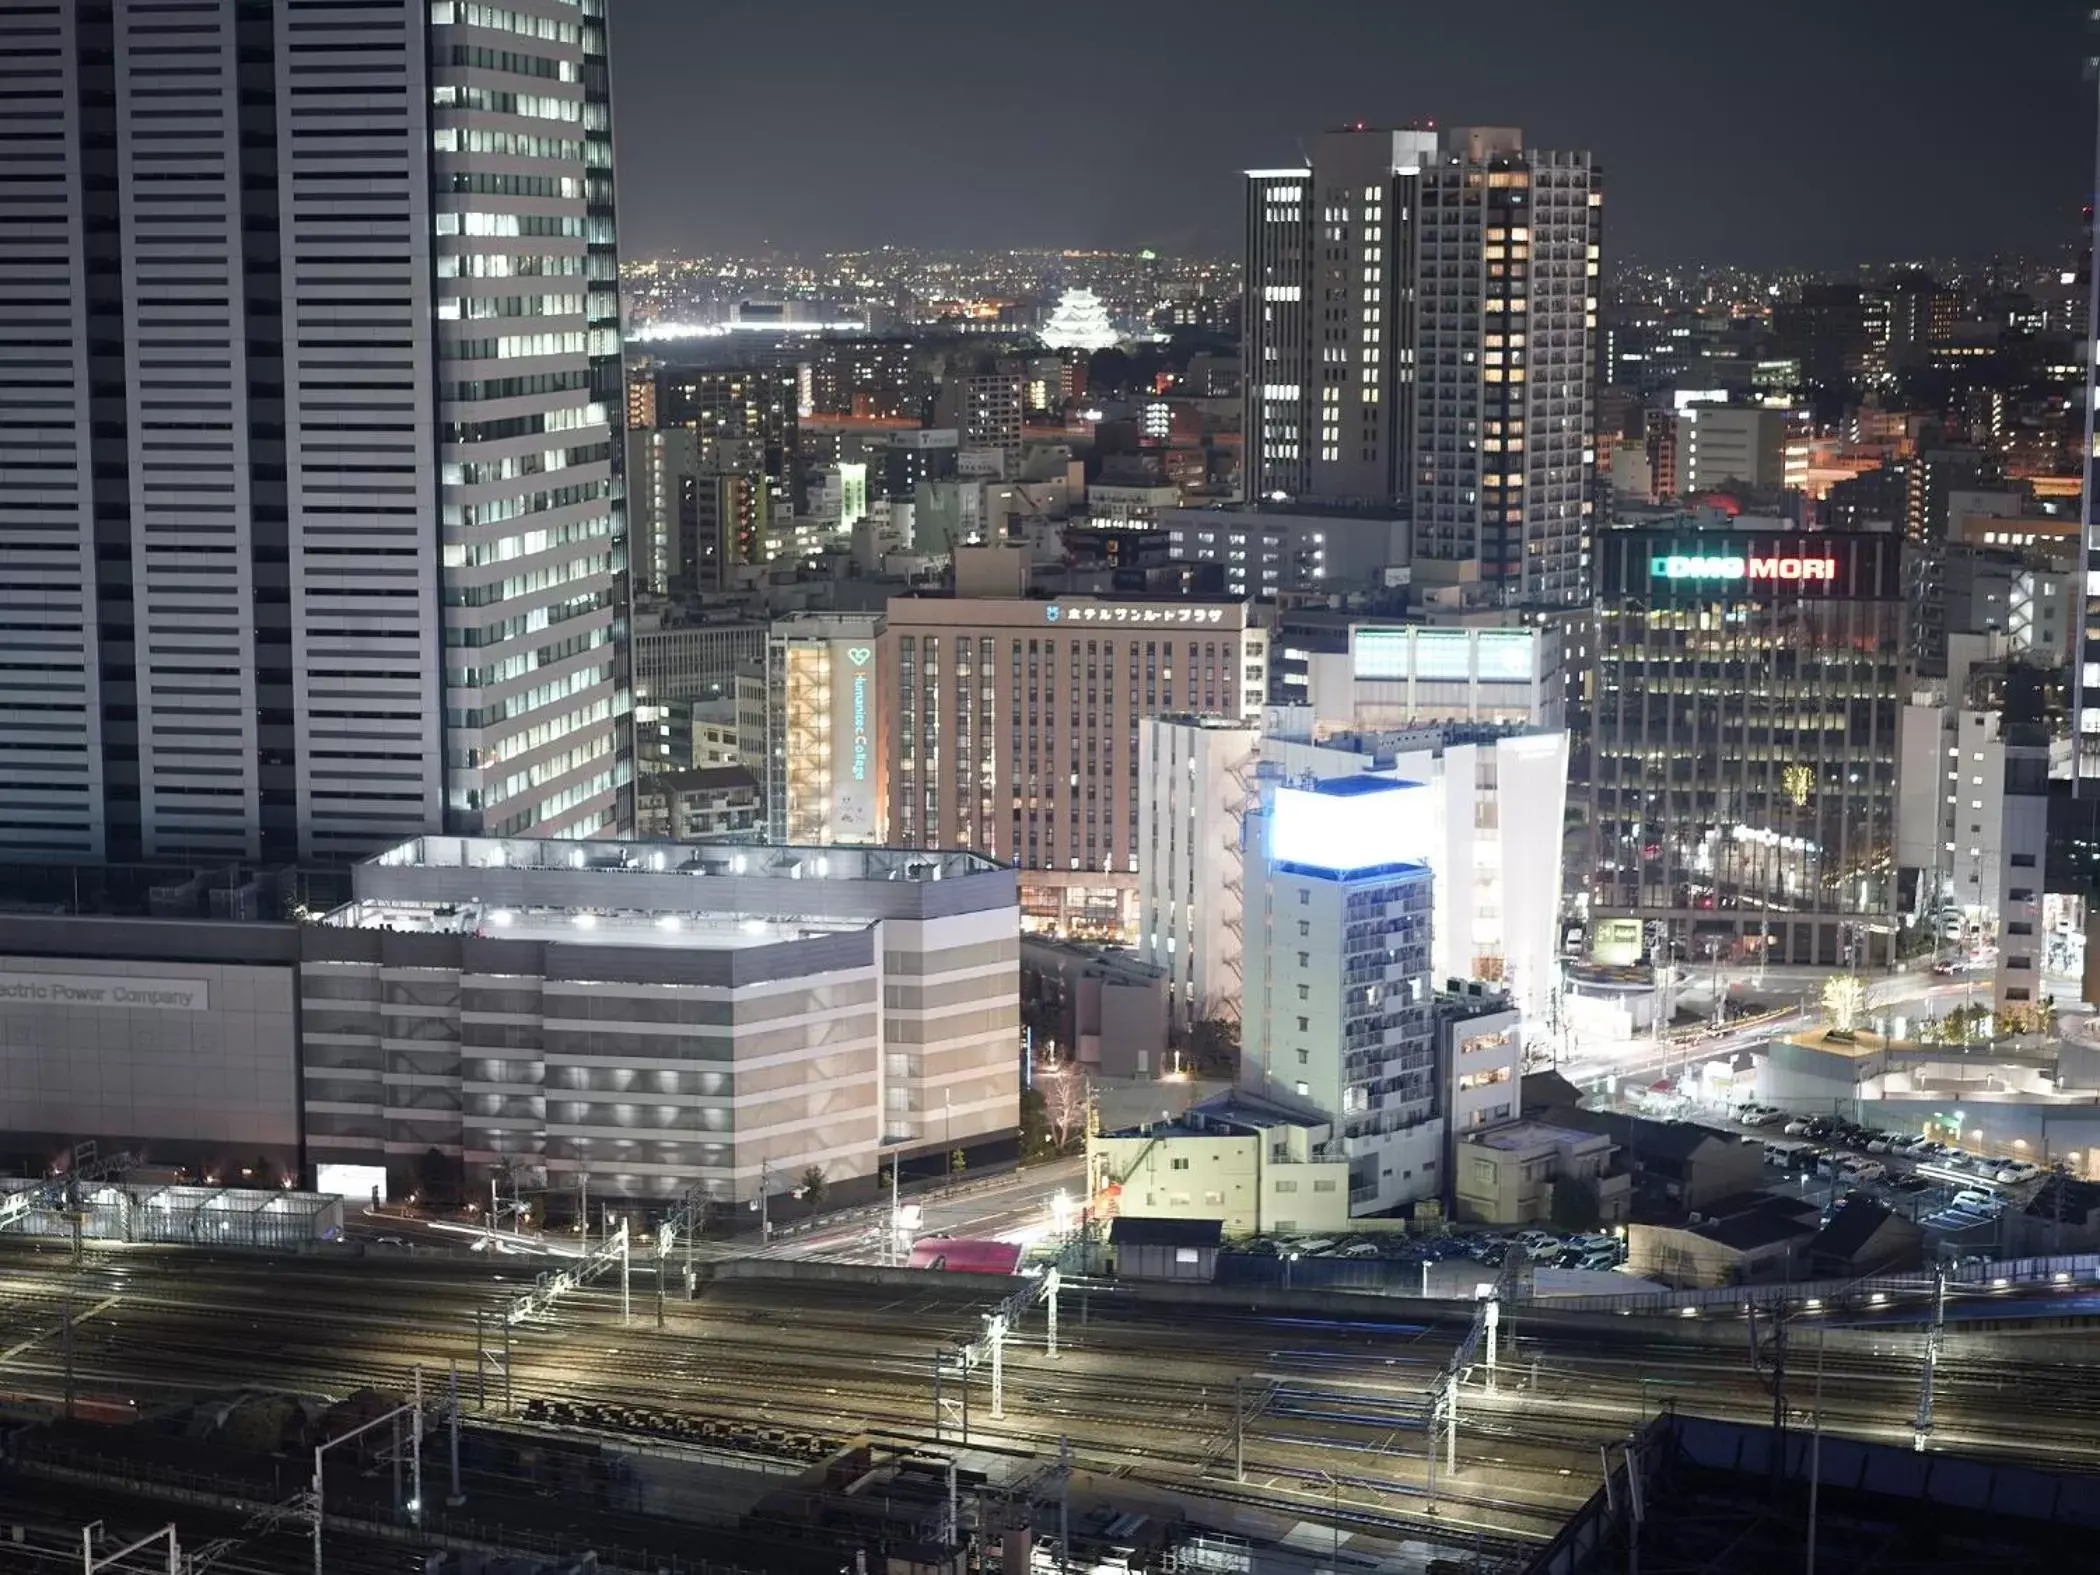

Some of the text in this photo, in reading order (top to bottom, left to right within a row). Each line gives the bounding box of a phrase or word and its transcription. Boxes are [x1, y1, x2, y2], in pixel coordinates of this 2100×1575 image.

[1750, 557, 1835, 579] MORI
[852, 735, 868, 781] College
[52, 984, 106, 1001] Power
[112, 986, 194, 1007] Company
